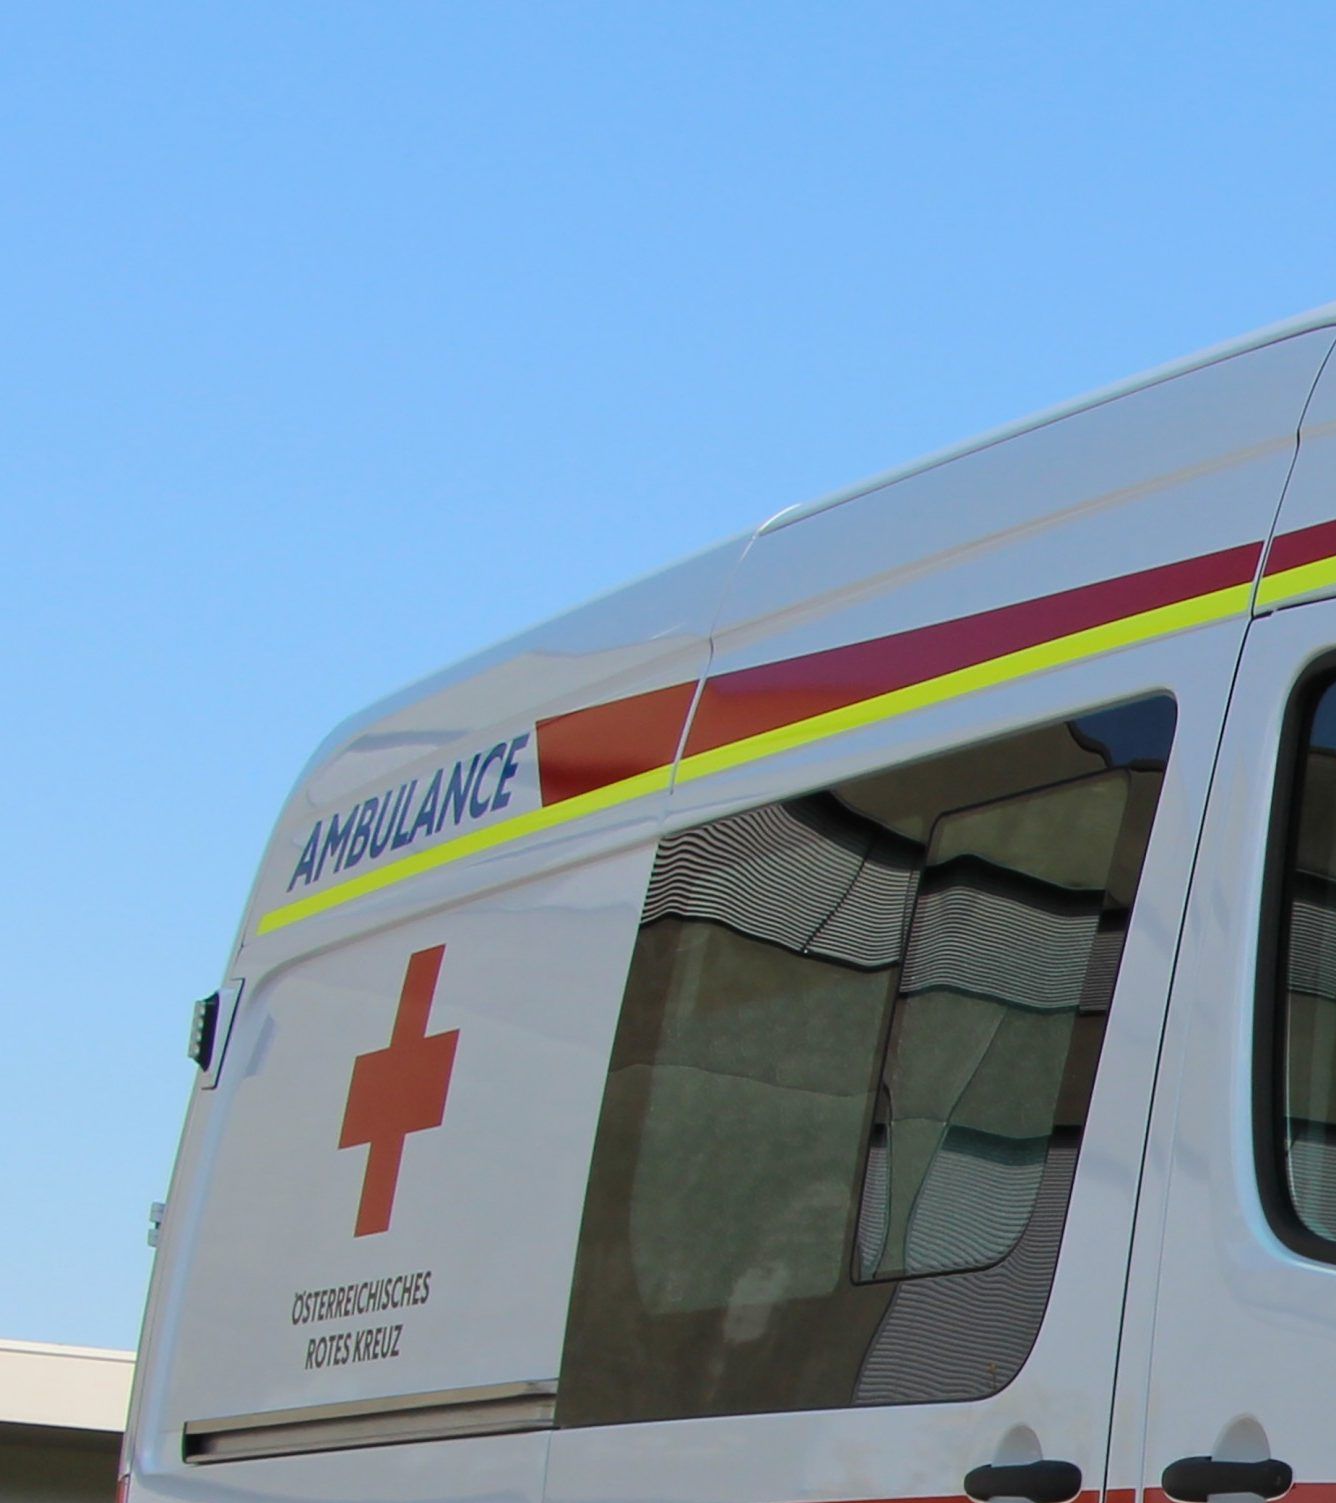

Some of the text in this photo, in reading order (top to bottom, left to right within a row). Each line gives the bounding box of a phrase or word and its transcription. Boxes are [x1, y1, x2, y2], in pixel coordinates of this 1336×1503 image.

[286, 732, 530, 892] AMBULANCE
[291, 1270, 432, 1326] ÖSTERREICHISCHES
[304, 1324, 404, 1370] ROTES KREUZ
